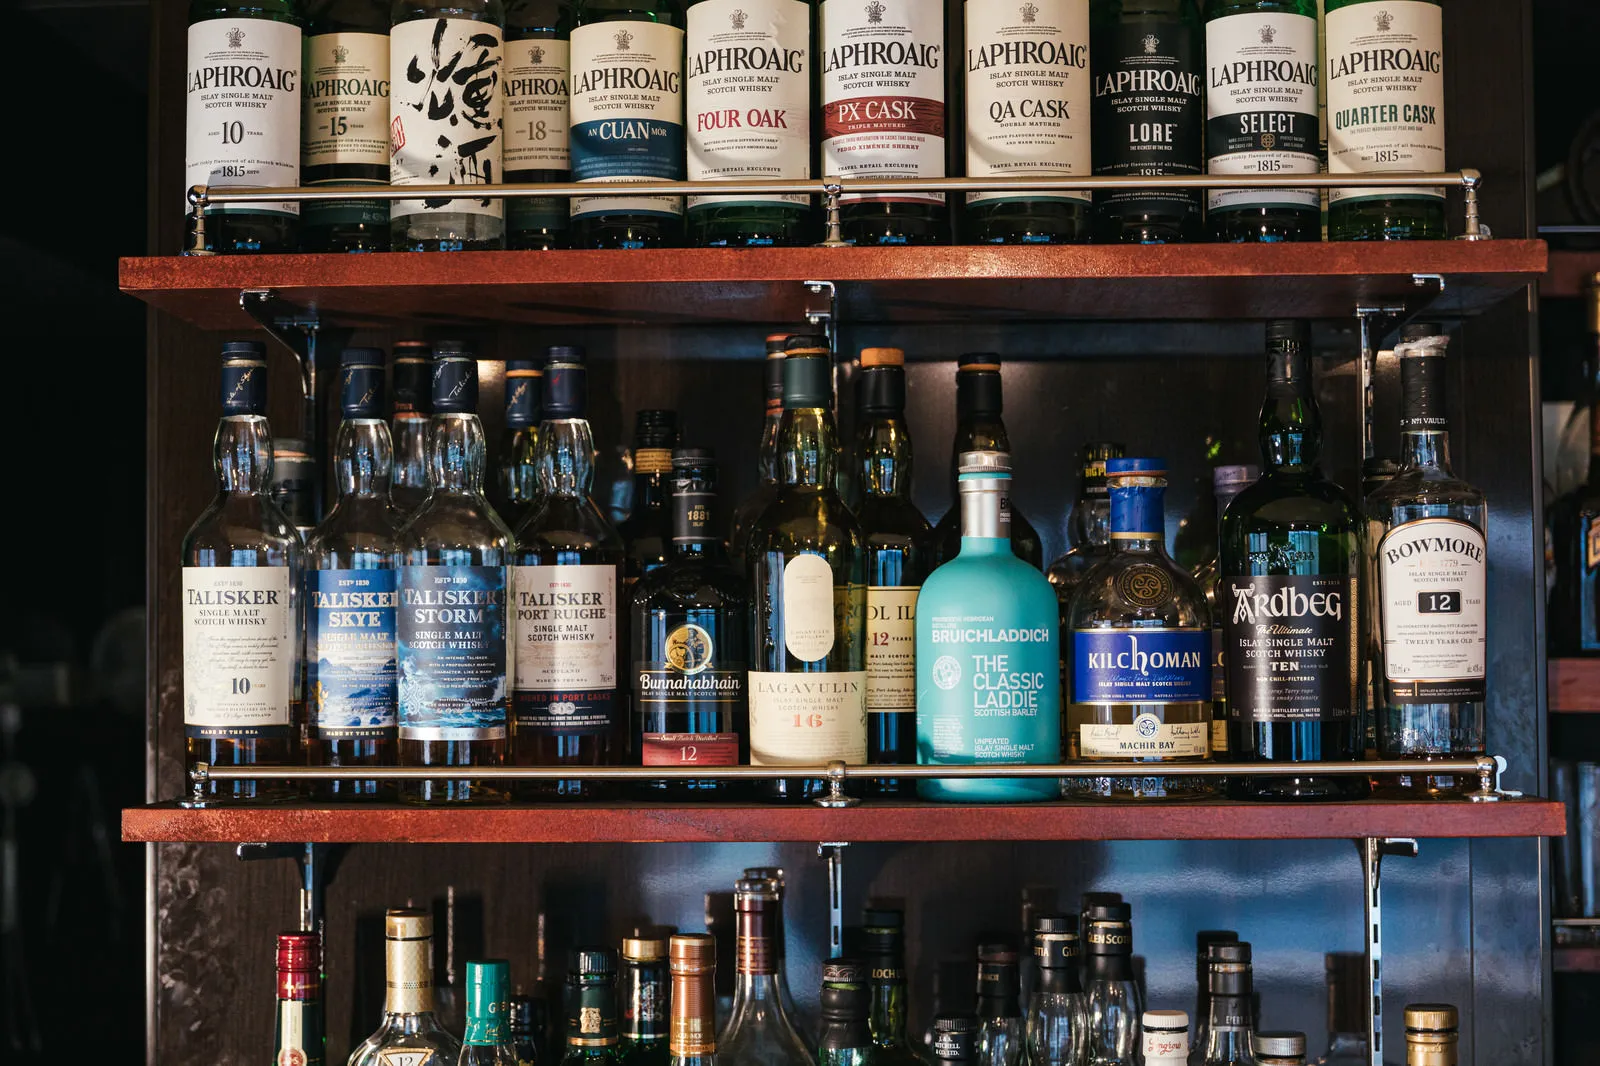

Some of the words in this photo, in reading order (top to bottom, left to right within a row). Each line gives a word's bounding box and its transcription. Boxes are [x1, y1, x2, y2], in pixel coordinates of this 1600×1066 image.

[688, 47, 803, 79] LAPHROAIG
[823, 41, 939, 74] LAPHROAIG
[968, 41, 1086, 72] LAPHROAIG
[1330, 48, 1441, 80] LAPHROAIG
[188, 65, 295, 93] LAPHROAIG
[838, 73, 858, 82] ISLAY
[894, 71, 917, 79] MALT
[989, 71, 1012, 80] ISLAY
[1014, 70, 1046, 78] SINGLE
[1048, 71, 1069, 79] MALT
[1211, 60, 1317, 88] LAPHROAIG
[503, 79, 570, 97] APHROA
[574, 67, 679, 96] LAPHROAIG
[702, 78, 722, 87] ISLAY
[724, 76, 755, 84] SINGLE
[757, 76, 780, 84] MALT
[843, 81, 874, 91] SCOTCH
[876, 80, 911, 88] WHISKY
[996, 80, 1029, 88] SCOTCH
[1031, 80, 1064, 88] WHISKY
[1095, 69, 1200, 97] LAPHROAIG
[1347, 78, 1367, 87] ISLAY
[1370, 76, 1401, 84] SINGLE
[1403, 76, 1423, 84] MALT
[707, 86, 736, 95] SCOTCH
[739, 85, 773, 93] WHISKY
[1230, 88, 1251, 96] ISLAY
[1353, 86, 1383, 94] SCOTCH
[588, 95, 608, 103] ISLAY
[1111, 97, 1133, 105] ISLAY
[1167, 97, 1187, 105] MALT
[1235, 96, 1265, 104] SCOTCH
[593, 103, 622, 111] SCOTCH
[838, 103, 861, 123] PX
[865, 101, 917, 121] CASK
[989, 100, 1016, 123] QA
[1020, 99, 1070, 120] CASK
[1117, 105, 1148, 113] SCOTCH
[1151, 105, 1182, 113] WHISKY
[697, 109, 742, 132] FOUR
[747, 108, 788, 129] OAK
[1239, 113, 1295, 134] SELECT
[1335, 104, 1398, 130] QUARTER
[1403, 104, 1436, 124] CASK
[222, 120, 245, 144] 10
[330, 116, 347, 136] 15
[527, 121, 547, 141] 18
[587, 128, 598, 137] AN
[600, 121, 650, 140] CUAN
[1129, 123, 1173, 142] LORE
[1374, 151, 1399, 163] 1815
[222, 166, 245, 177] 1815
[1257, 160, 1281, 172] 1815
[687, 510, 710, 521] 1881
[1386, 538, 1483, 565] BOWMORE
[188, 589, 280, 605] TALISKER
[404, 588, 498, 605] TALISKER
[520, 592, 602, 607] TALISKER
[1430, 594, 1451, 611] 12
[328, 612, 381, 628] SKYE
[414, 608, 484, 624] STORM
[518, 609, 550, 621] PORT
[553, 608, 606, 620] RUIGHE
[193, 618, 226, 626] SCOTCH
[228, 618, 267, 626] WHISKY
[534, 625, 563, 633] SINGLE
[565, 624, 588, 632] MALT
[932, 628, 1049, 643] BRUICHLADDICH
[1255, 624, 1274, 635] The
[1273, 624, 1313, 634] Ultimate
[527, 633, 559, 642] SCOTCH
[561, 633, 595, 641] WHISKY
[872, 632, 890, 646] 12
[1239, 638, 1262, 647] ISLAY
[1265, 638, 1303, 647] SINGLE
[1307, 638, 1334, 646] MALT
[408, 641, 445, 649] SCOTCH
[448, 641, 490, 649] WHISKY
[1246, 650, 1281, 658] SCOTCH
[1284, 649, 1326, 658] WHISKY
[972, 655, 1009, 673] THE
[1270, 662, 1300, 672] TEN
[231, 677, 250, 695] 10
[640, 674, 741, 690] Bunnahabhain
[757, 682, 859, 694] LAGAVULIN
[973, 672, 1044, 690] CLASSIC
[974, 690, 1038, 709] LADDIE
[974, 709, 1011, 717] SCOTTISH
[1012, 708, 1038, 716] BARLEY
[793, 714, 823, 728] 16
[1119, 742, 1156, 750] MACHIR
[1158, 741, 1176, 749] BAY
[679, 746, 698, 761] 12
[872, 969, 896, 979] LOCH
[396, 1056, 414, 1066] 12
